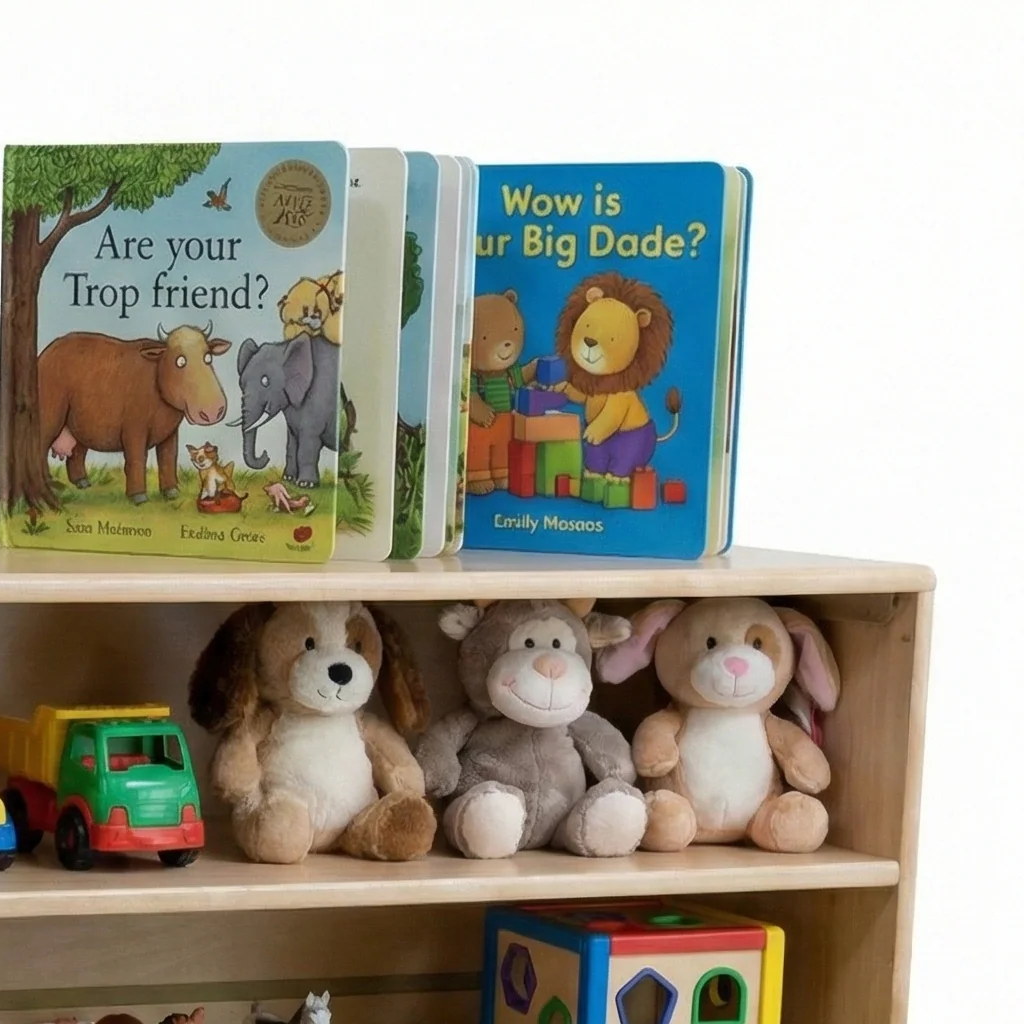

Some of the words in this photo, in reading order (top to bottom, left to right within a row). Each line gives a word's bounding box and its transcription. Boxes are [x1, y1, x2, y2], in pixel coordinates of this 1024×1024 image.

[500, 183, 583, 217] Wow
[594, 182, 622, 217] is
[94, 224, 154, 260] Are
[165, 234, 242, 271] your
[523, 224, 577, 269] Big
[588, 221, 707, 259] Dade?
[63, 271, 140, 319] Trop
[151, 269, 270, 311] friend?
